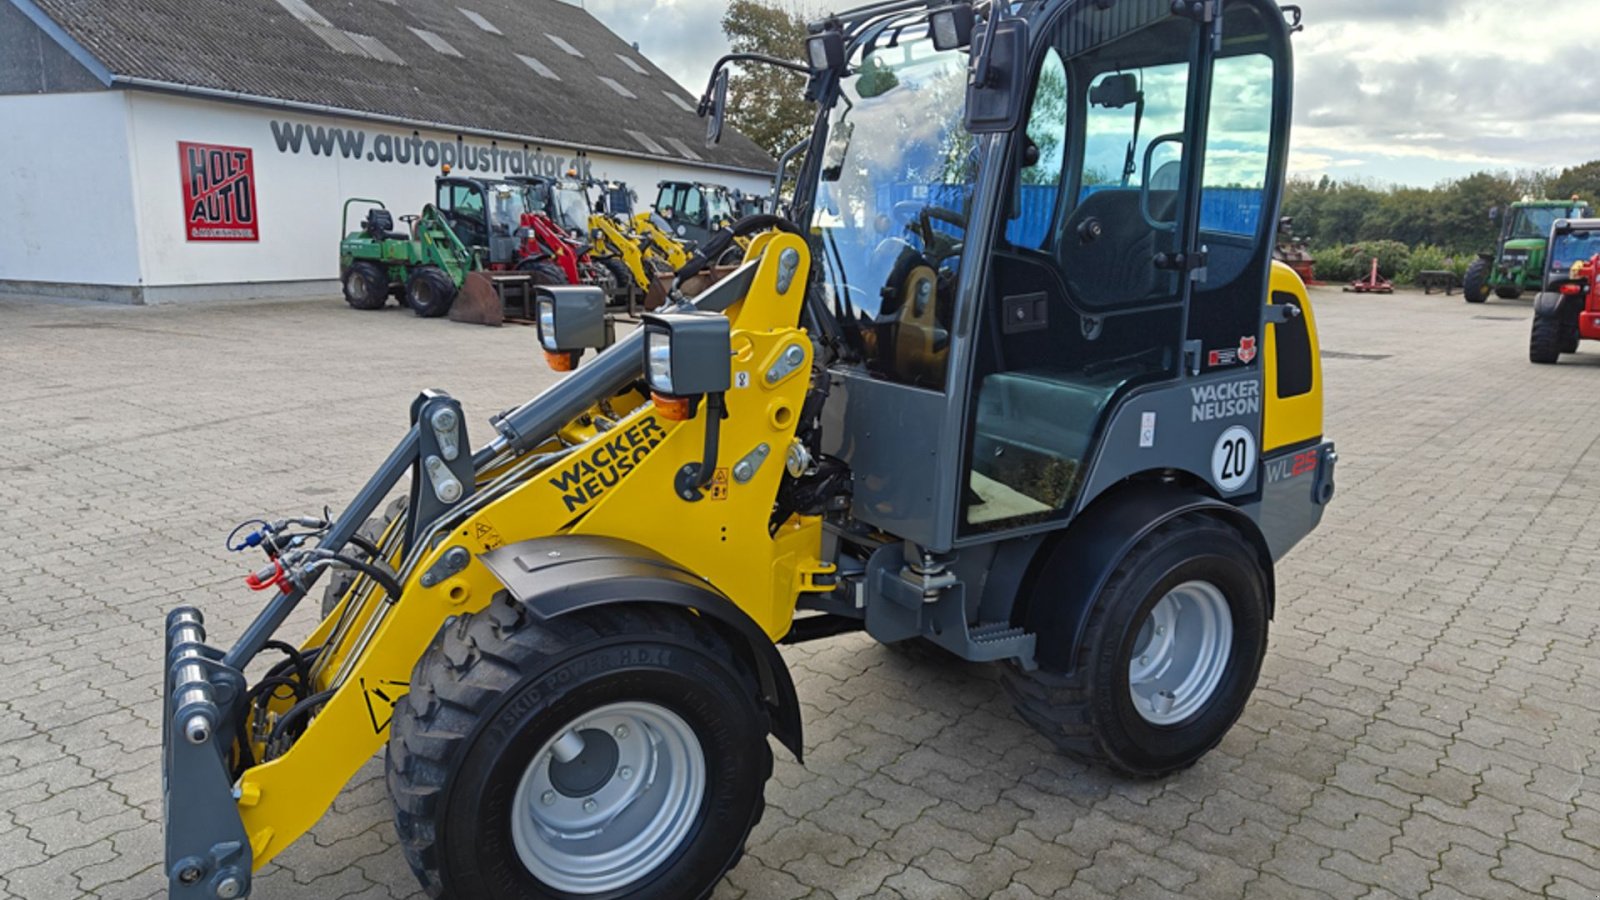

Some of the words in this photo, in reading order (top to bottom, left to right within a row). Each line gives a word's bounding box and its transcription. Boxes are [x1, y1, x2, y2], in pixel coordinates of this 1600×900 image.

[188, 147, 248, 199] HOLT
[190, 174, 253, 223] AUTO
[1191, 380, 1260, 404] WACKER
[1191, 397, 1260, 423] NEUSON
[549, 416, 662, 492] WACKER
[1221, 437, 1247, 480] 20
[1265, 450, 1318, 483] WL25
